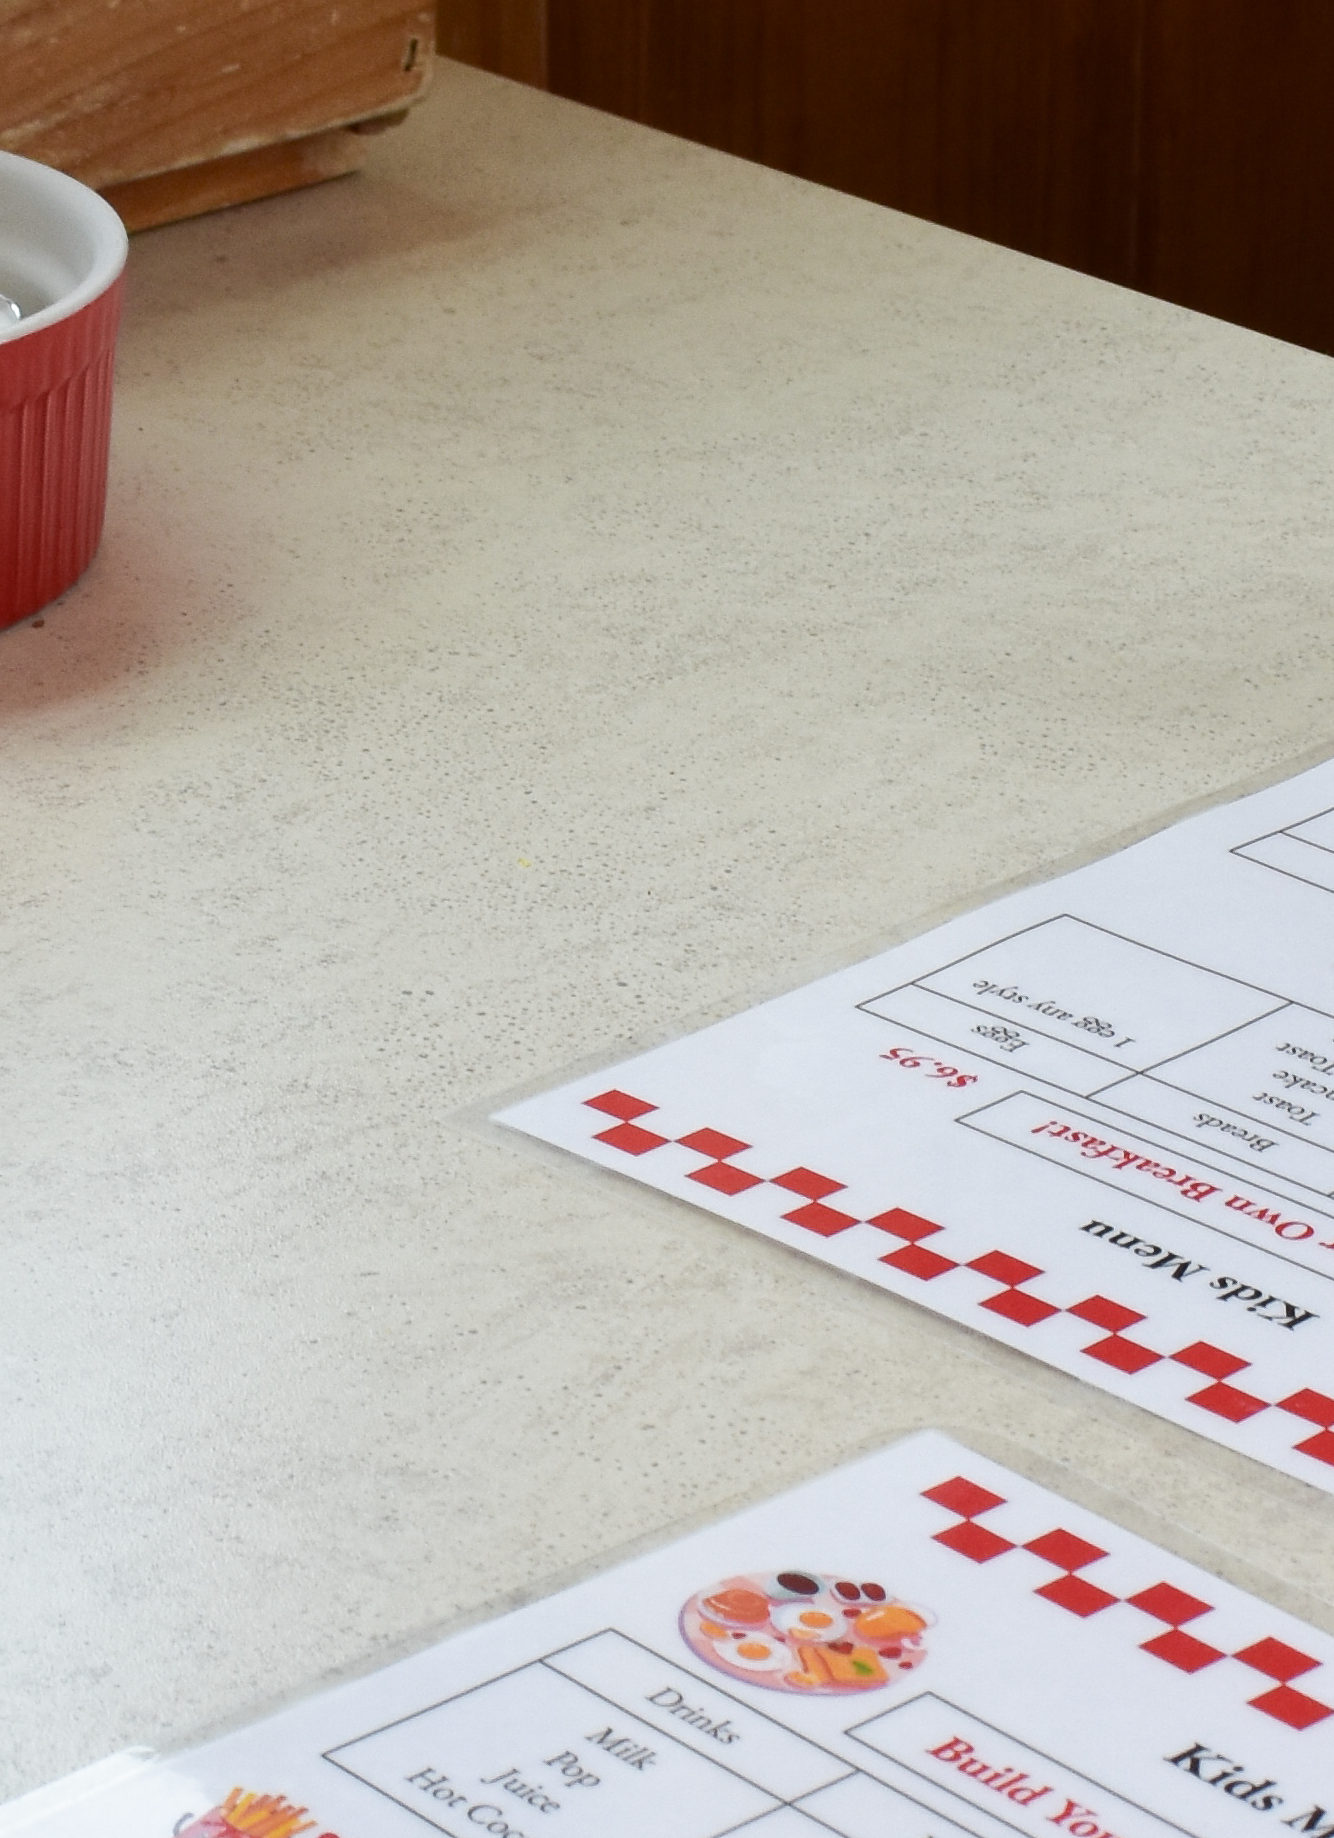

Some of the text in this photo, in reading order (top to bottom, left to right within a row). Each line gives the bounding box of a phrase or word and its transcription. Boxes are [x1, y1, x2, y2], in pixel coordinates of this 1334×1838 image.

[971, 978, 1138, 1049] 1 egg any style
[970, 1023, 1031, 1053] Eggs
[879, 1046, 979, 1089] $6.95
[1192, 1110, 1281, 1154] Breads
[1251, 1091, 1324, 1127] Toast
[1030, 1119, 1224, 1204] Breakfast!
[1224, 1193, 1315, 1242] Own
[1077, 1217, 1322, 1333] Kids Menu
[645, 1686, 741, 1745] Drinks
[544, 1750, 602, 1789] Pop
[584, 1727, 657, 1772] Milk
[925, 1736, 1055, 1807] Build
[405, 1767, 468, 1808] Hot
[480, 1768, 561, 1815] Juice
[1162, 1742, 1285, 1812] Kids
